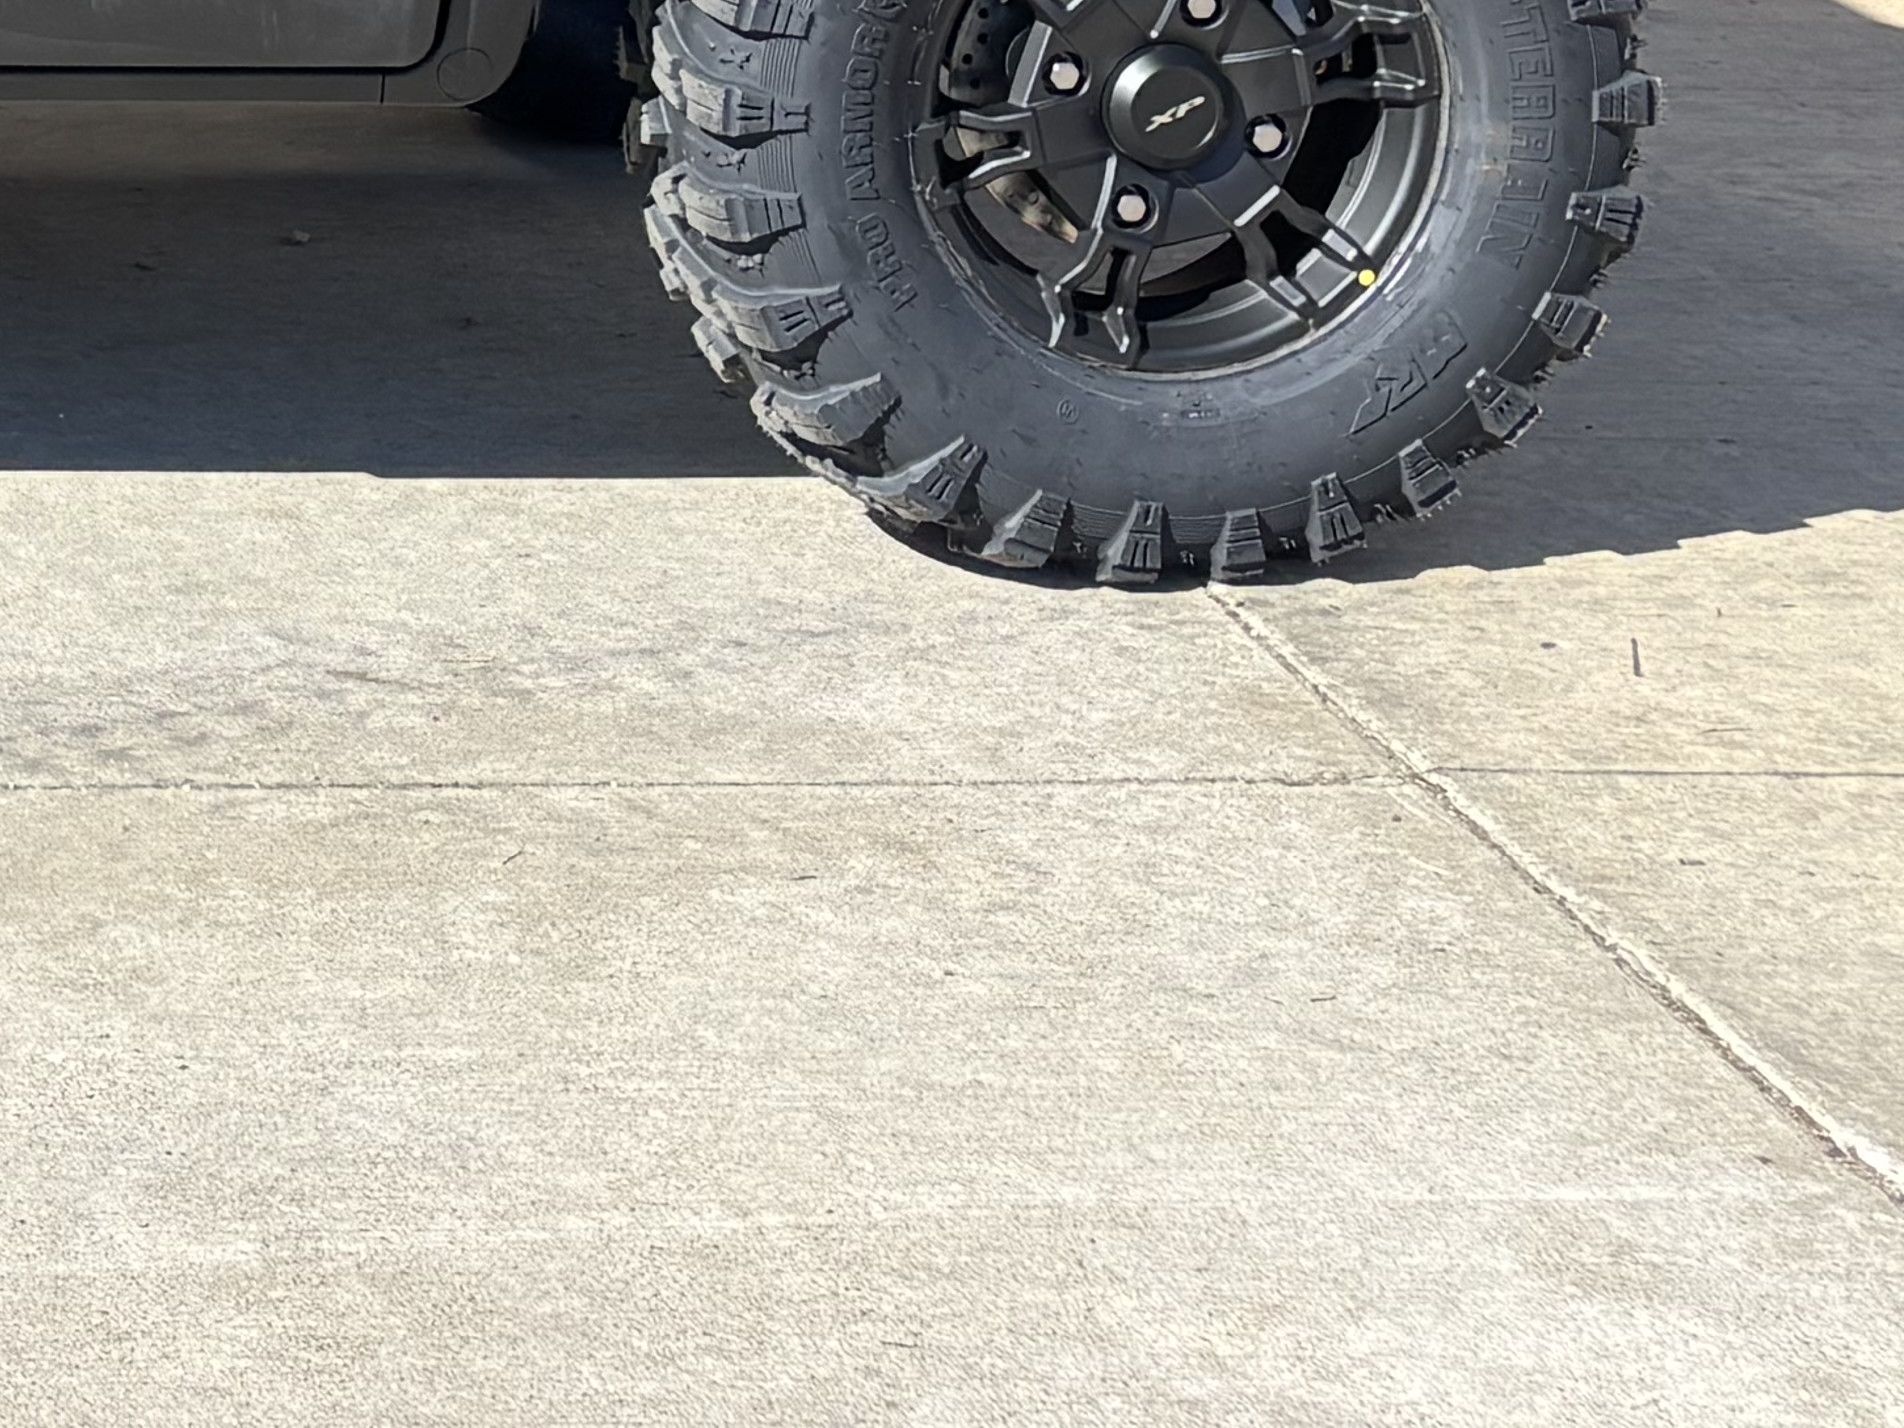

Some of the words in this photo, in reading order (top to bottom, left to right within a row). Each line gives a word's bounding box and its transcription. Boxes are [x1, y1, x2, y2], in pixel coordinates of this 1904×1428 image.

[841, 21, 891, 203] ARMOR
[1144, 95, 1207, 133] XP
[855, 212, 919, 313] PRO
